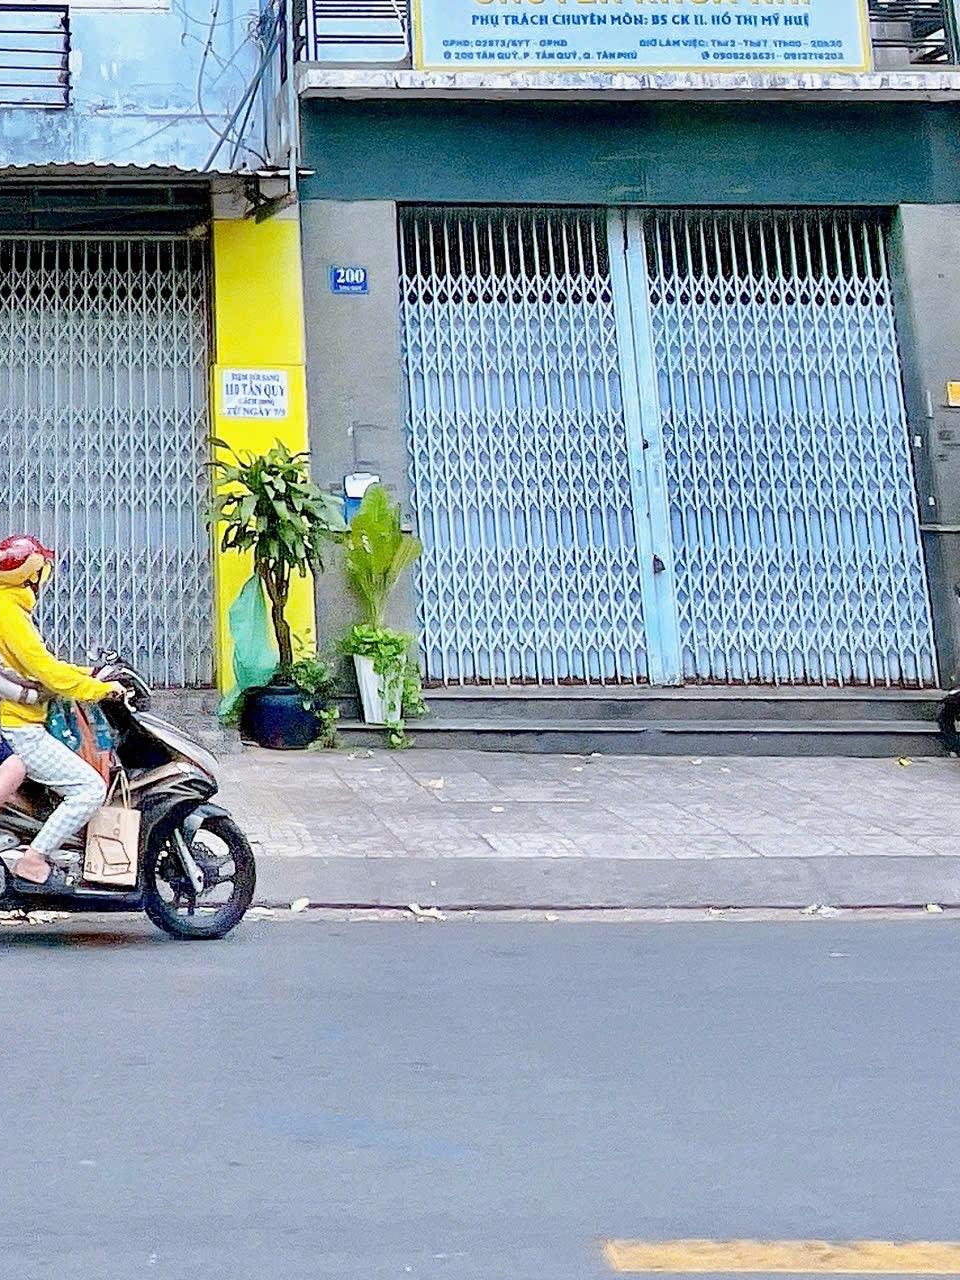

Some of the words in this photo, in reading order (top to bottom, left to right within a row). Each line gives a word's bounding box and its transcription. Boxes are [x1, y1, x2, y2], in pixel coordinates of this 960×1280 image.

[471, 13, 500, 28] PHỤ
[502, 11, 549, 26] TRÁCH
[552, 11, 607, 26] CHUYÊN
[651, 14, 668, 26] BS
[672, 14, 690, 26] CK
[336, 268, 365, 283] 200
